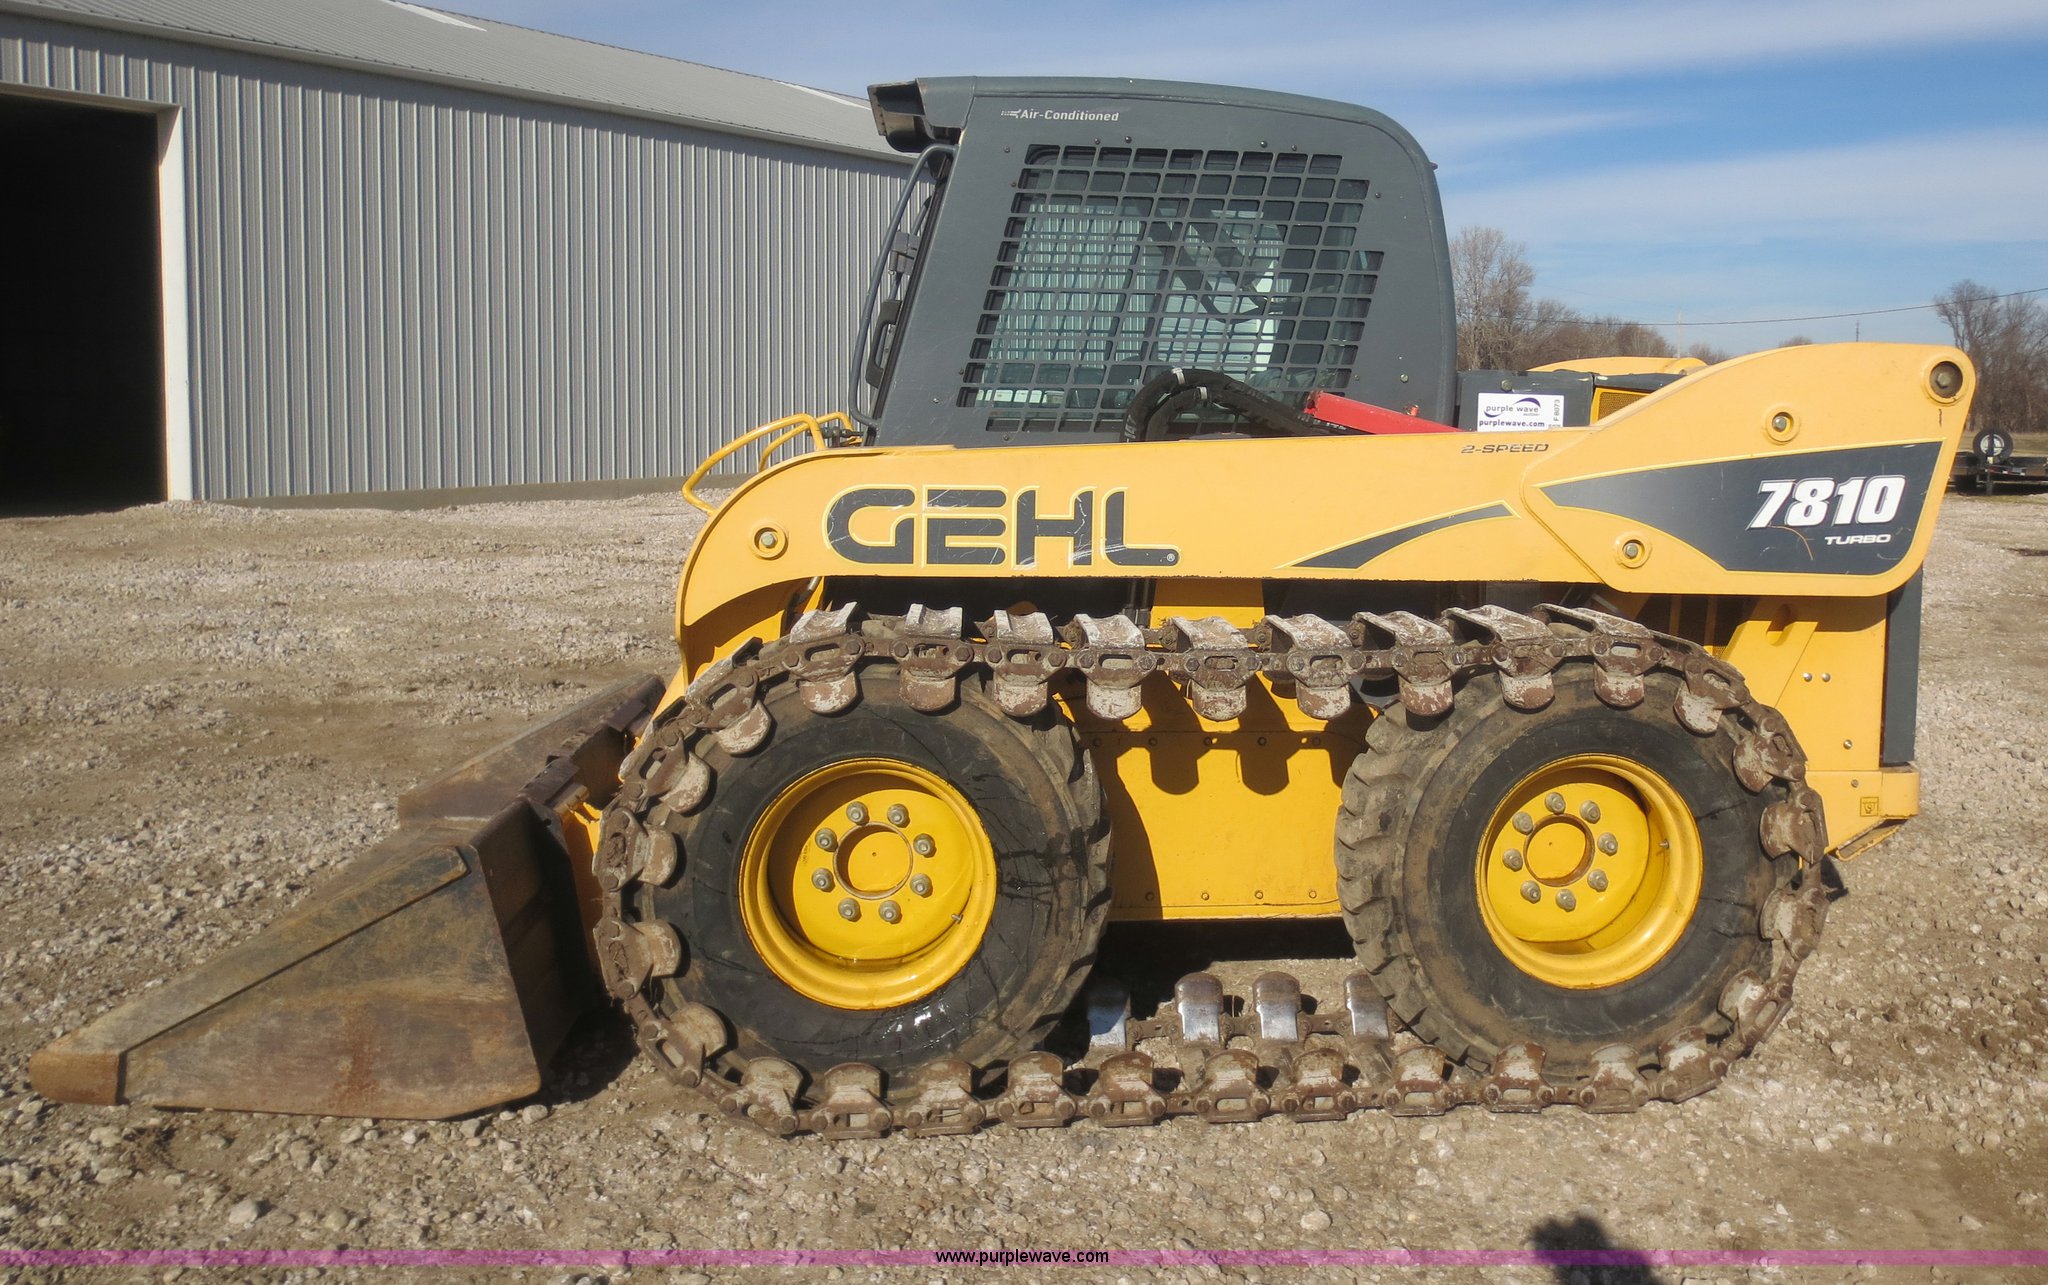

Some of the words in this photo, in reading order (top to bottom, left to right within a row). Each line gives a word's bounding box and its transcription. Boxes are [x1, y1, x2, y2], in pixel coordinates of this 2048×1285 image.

[1020, 108, 1120, 121] Air-Conditioned
[1486, 405, 1514, 413] purple
[1479, 419, 1545, 427] purplewave.com
[1460, 443, 1550, 454] 2-SPEED
[1745, 475, 1906, 531] 7810
[823, 485, 1182, 568] GEHL
[1824, 534, 1892, 545] TURBO
